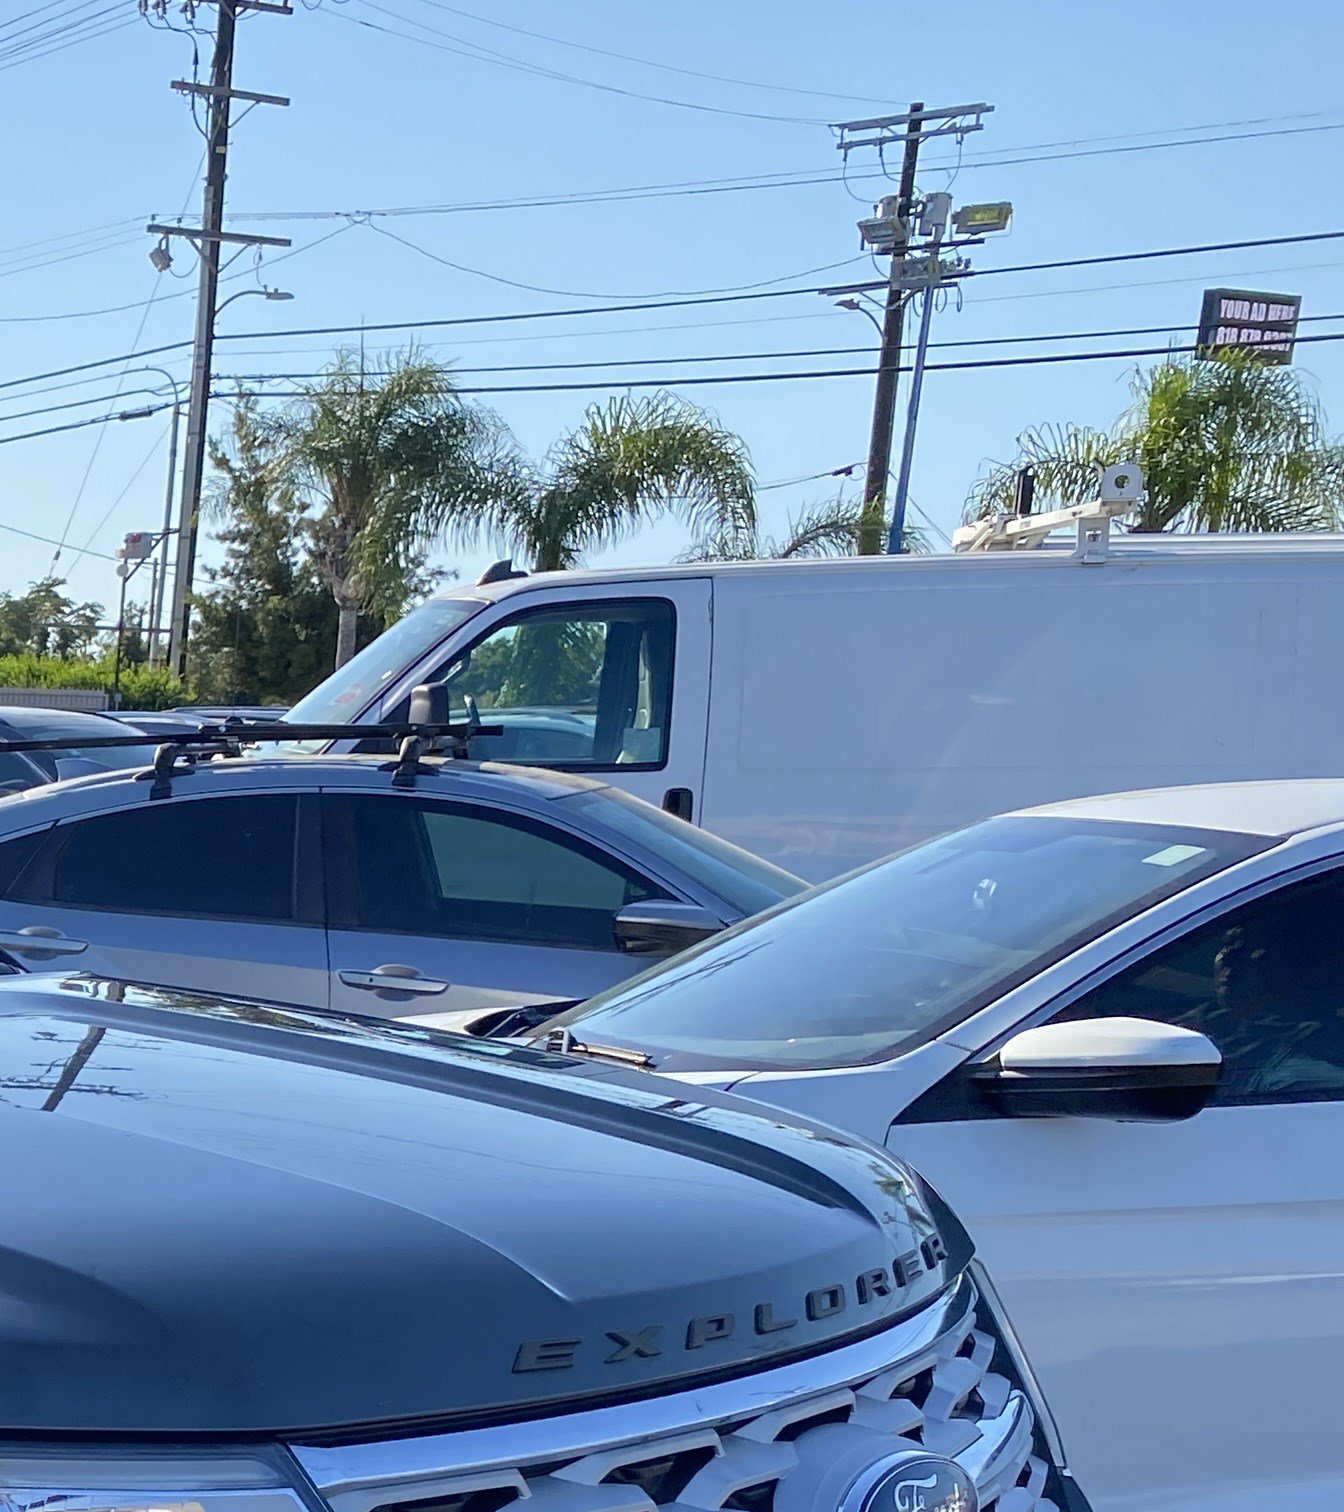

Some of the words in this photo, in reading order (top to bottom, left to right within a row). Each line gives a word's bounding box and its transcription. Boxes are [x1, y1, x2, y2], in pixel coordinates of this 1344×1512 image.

[1220, 298, 1251, 320] YOUR
[1250, 302, 1267, 321] AD
[512, 1233, 949, 1374] EXPLORER
